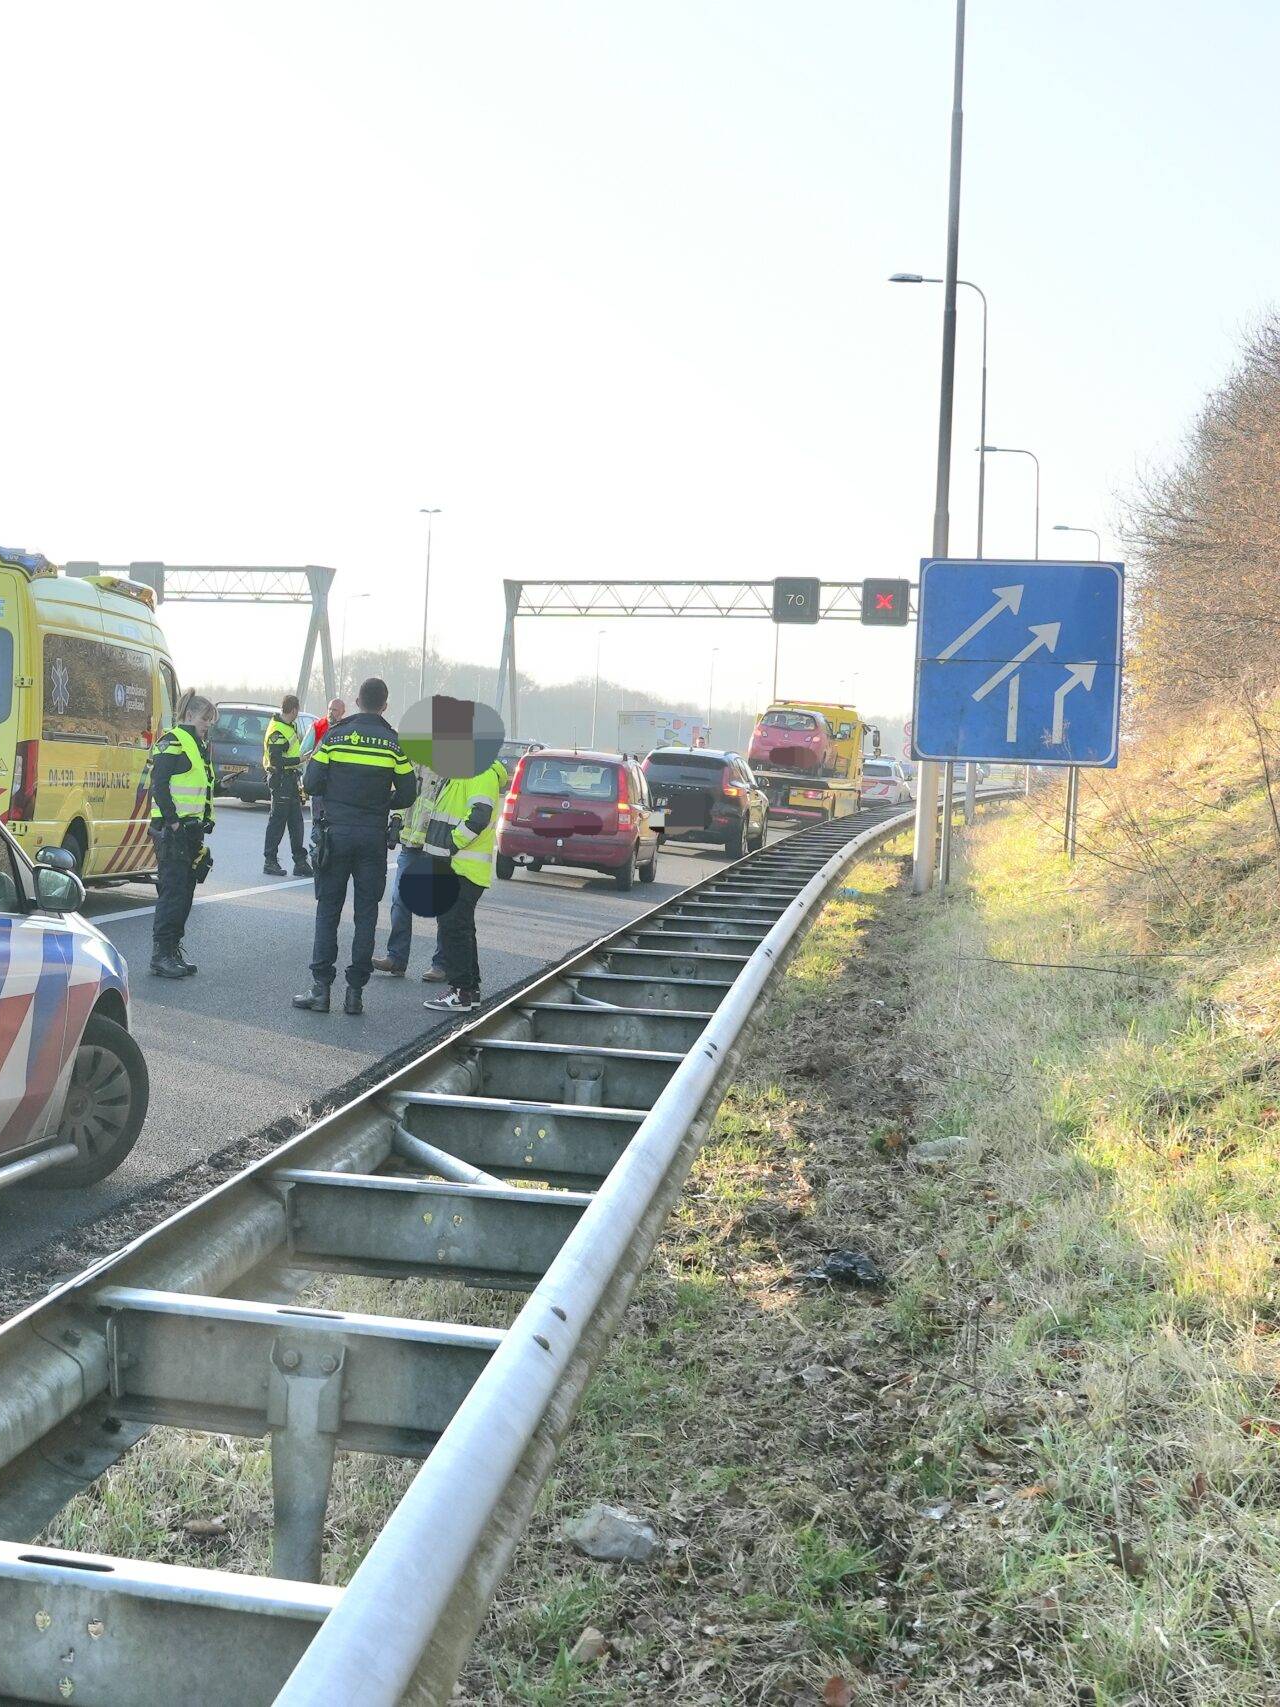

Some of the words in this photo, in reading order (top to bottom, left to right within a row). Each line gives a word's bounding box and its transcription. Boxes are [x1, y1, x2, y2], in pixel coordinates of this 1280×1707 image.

[786, 594, 805, 606] 70
[344, 731, 389, 746] POLITIE
[83, 771, 130, 789] AMBULANCE
